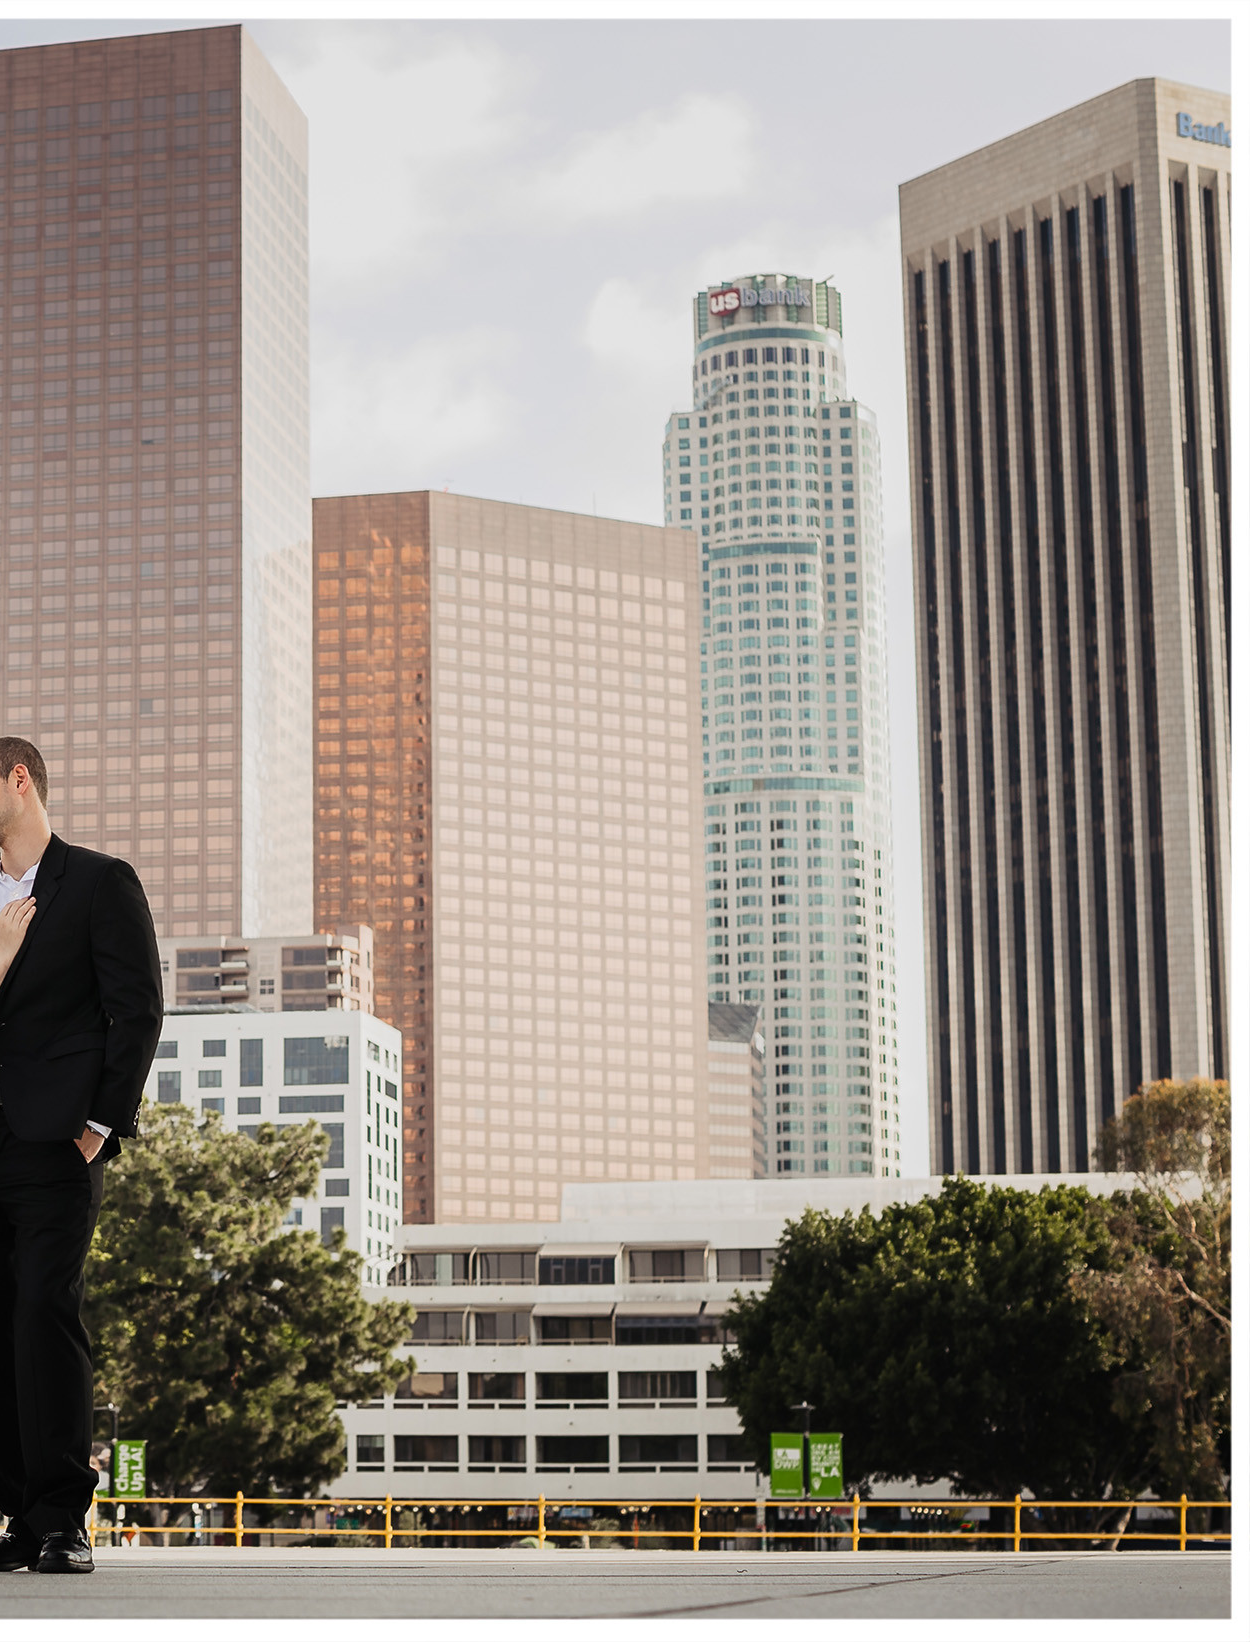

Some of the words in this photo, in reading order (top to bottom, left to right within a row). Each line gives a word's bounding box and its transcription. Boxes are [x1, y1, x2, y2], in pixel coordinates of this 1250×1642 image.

[114, 1444, 130, 1492] Charge
[130, 1447, 144, 1471] LA!
[130, 1471, 146, 1492] Up
[821, 1467, 840, 1477] LA
